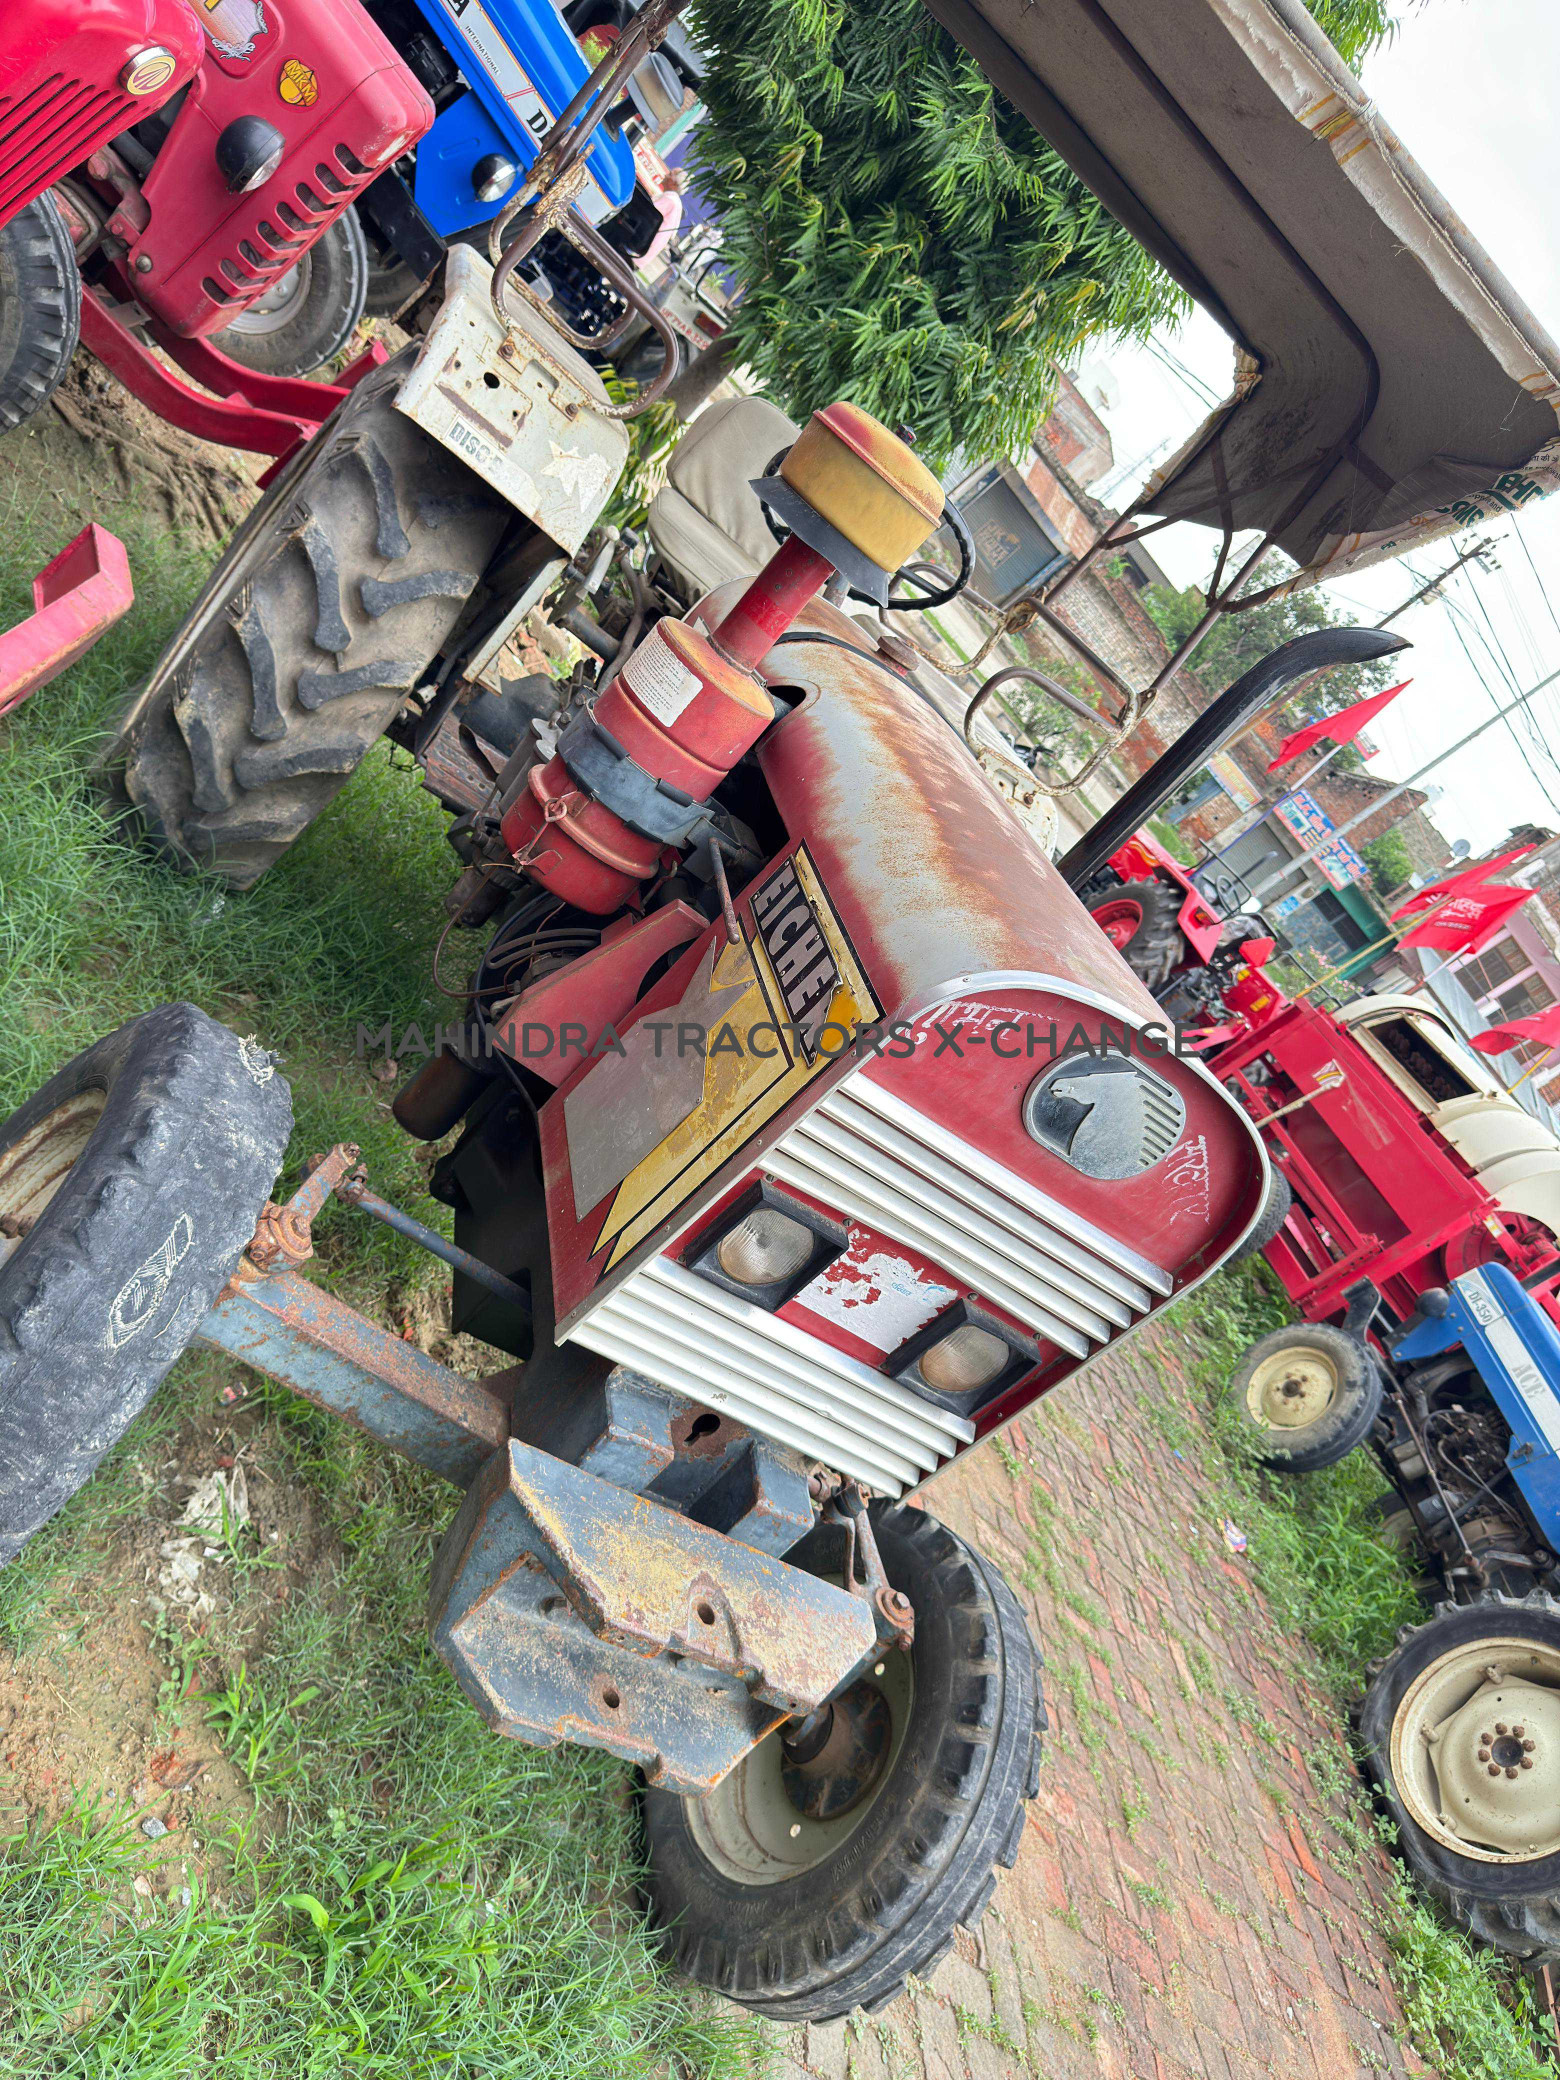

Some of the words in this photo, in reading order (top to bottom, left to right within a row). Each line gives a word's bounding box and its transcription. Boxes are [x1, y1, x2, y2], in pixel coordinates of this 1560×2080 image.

[465, 25, 501, 76] INTERNATIONAL
[285, 60, 317, 103] MKM
[1468, 1291, 1493, 1325] DI-350
[1512, 1364, 1546, 1399] ACE
